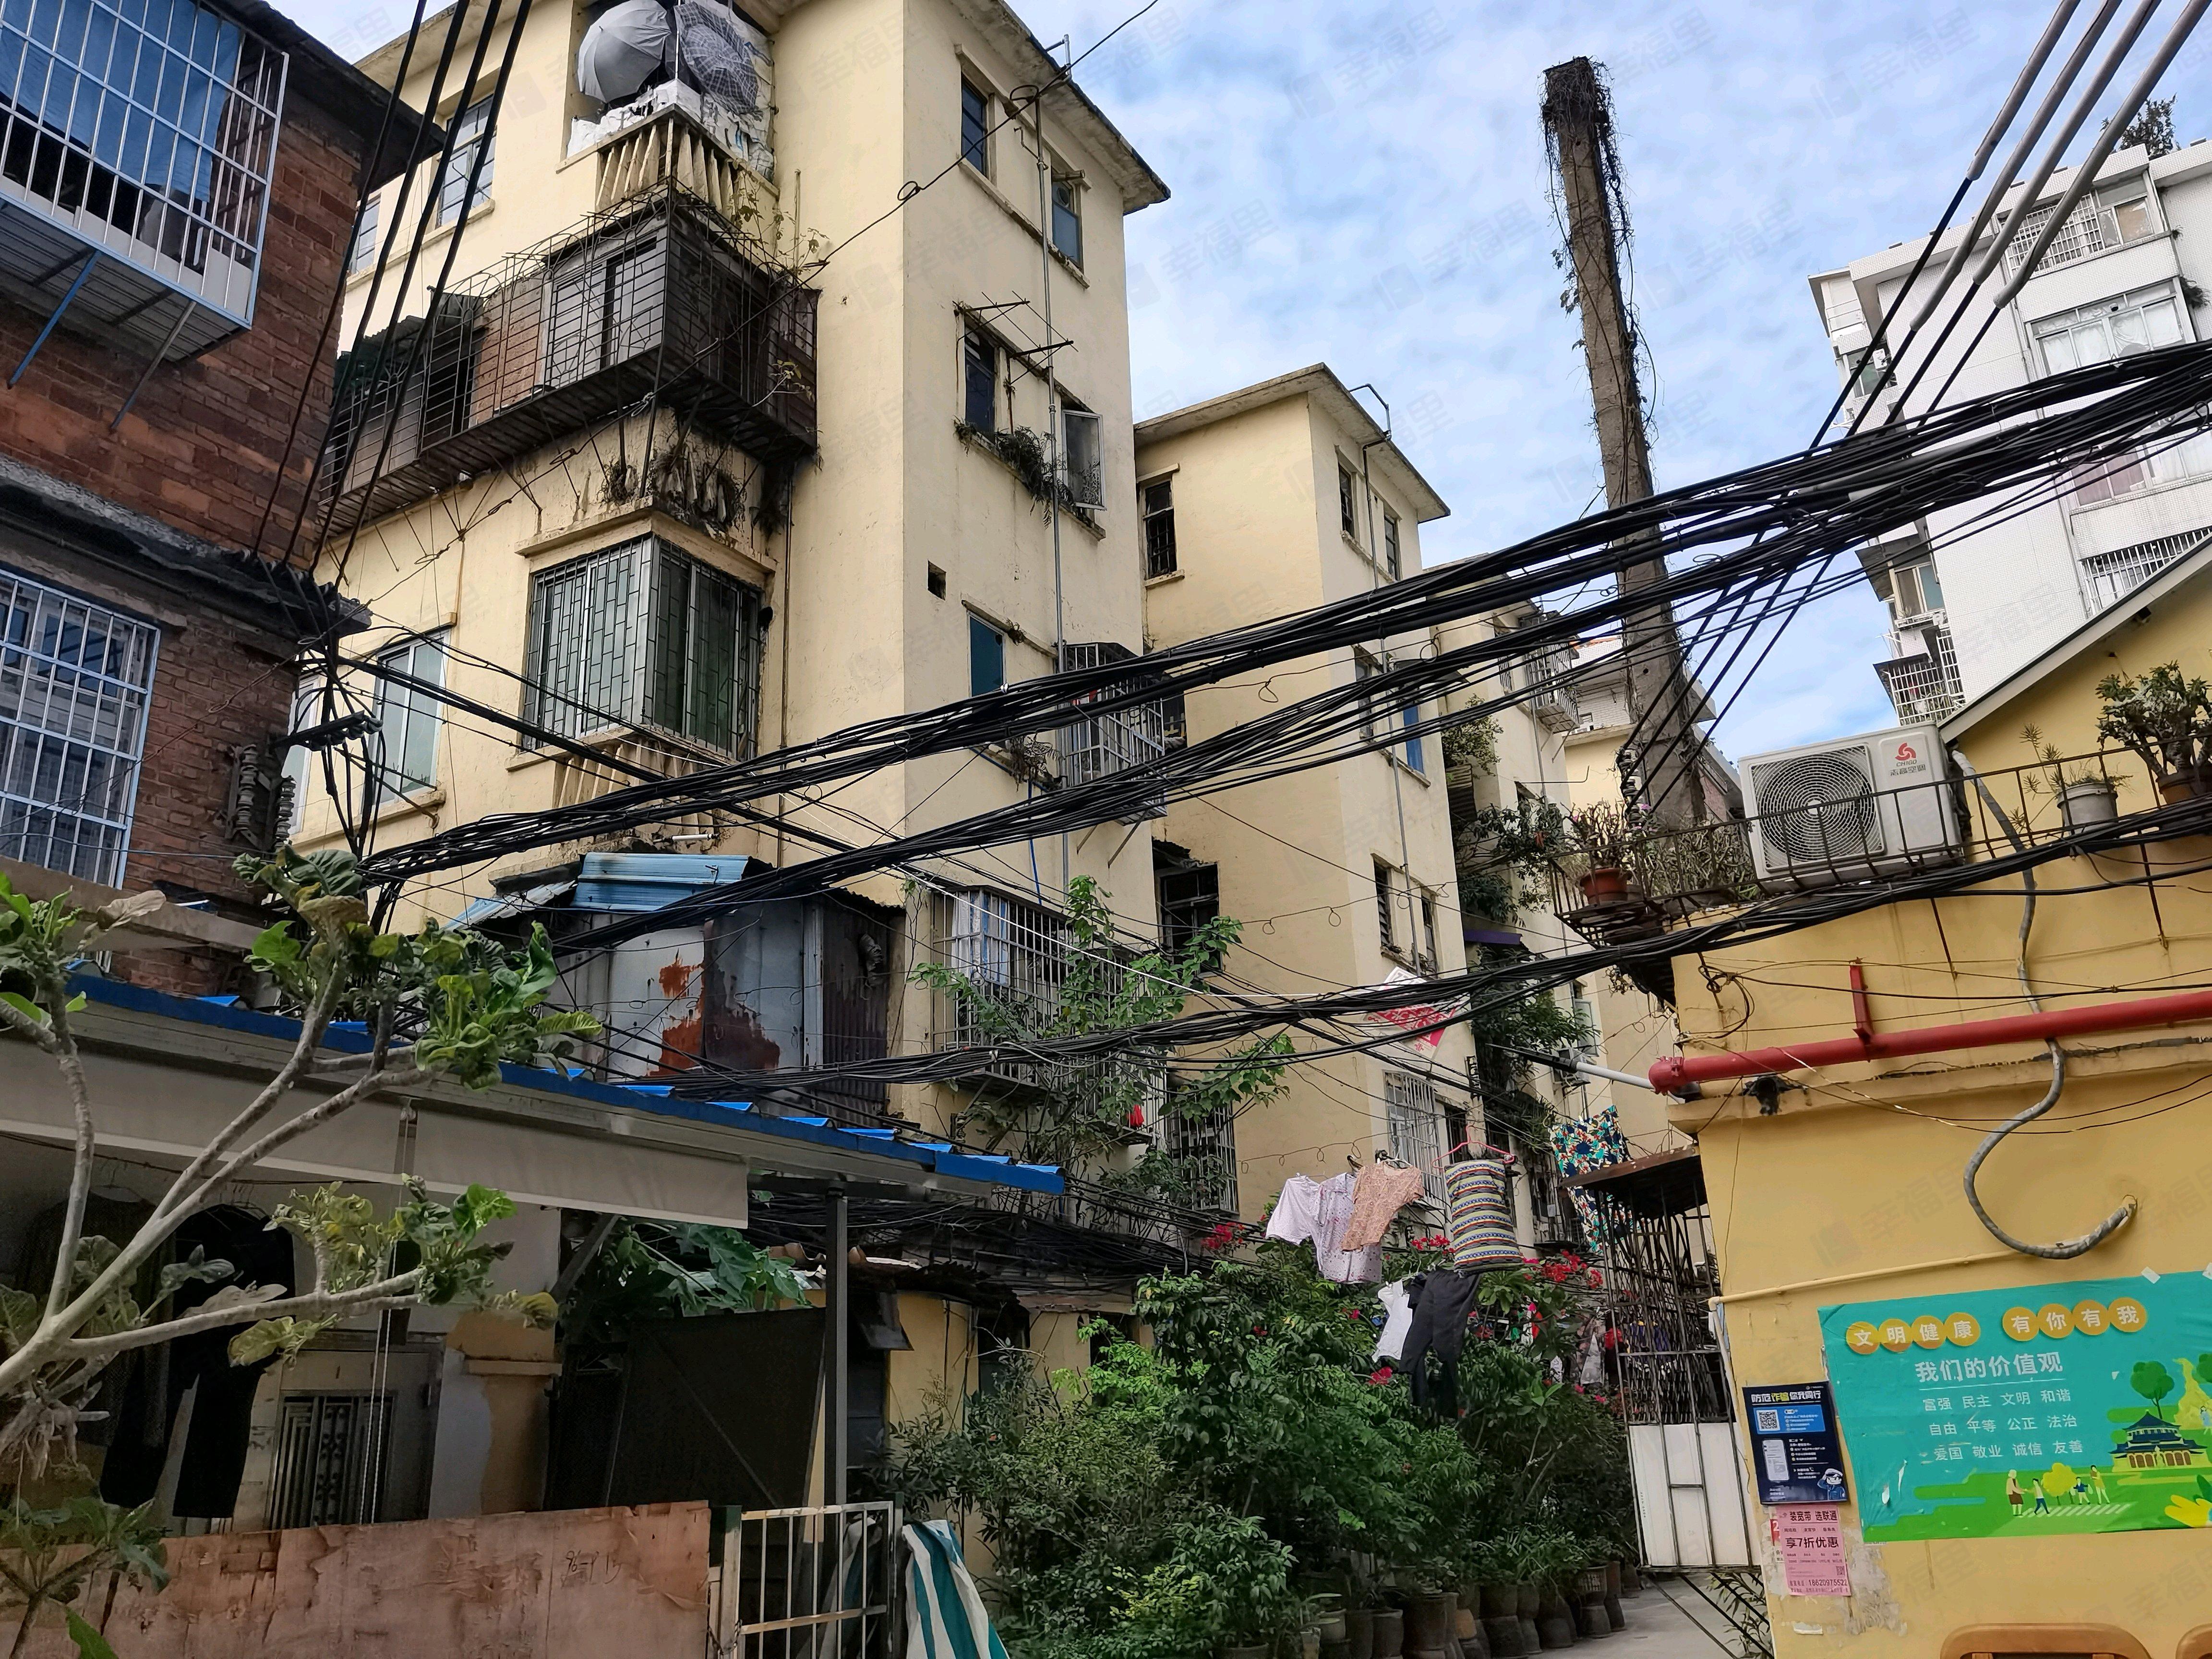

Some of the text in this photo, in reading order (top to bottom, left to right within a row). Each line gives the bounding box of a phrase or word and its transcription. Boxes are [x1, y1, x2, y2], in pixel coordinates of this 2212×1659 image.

[1896, 759, 1917, 767] CHIGO
[1854, 1305, 2140, 1347] 文明健康 有你有我
[1914, 1352, 2063, 1383] 我们的价值观
[1923, 1389, 2071, 1411] 富强 民主 文明 和谐
[1929, 1414, 2078, 1436] 自由 平等 公正 法治
[1934, 1440, 2083, 1461] 爱国 敬业 诚信 友善
[1790, 1510, 1811, 1521] 装宽带
[1785, 1537, 1839, 1549] 享7折优惠
